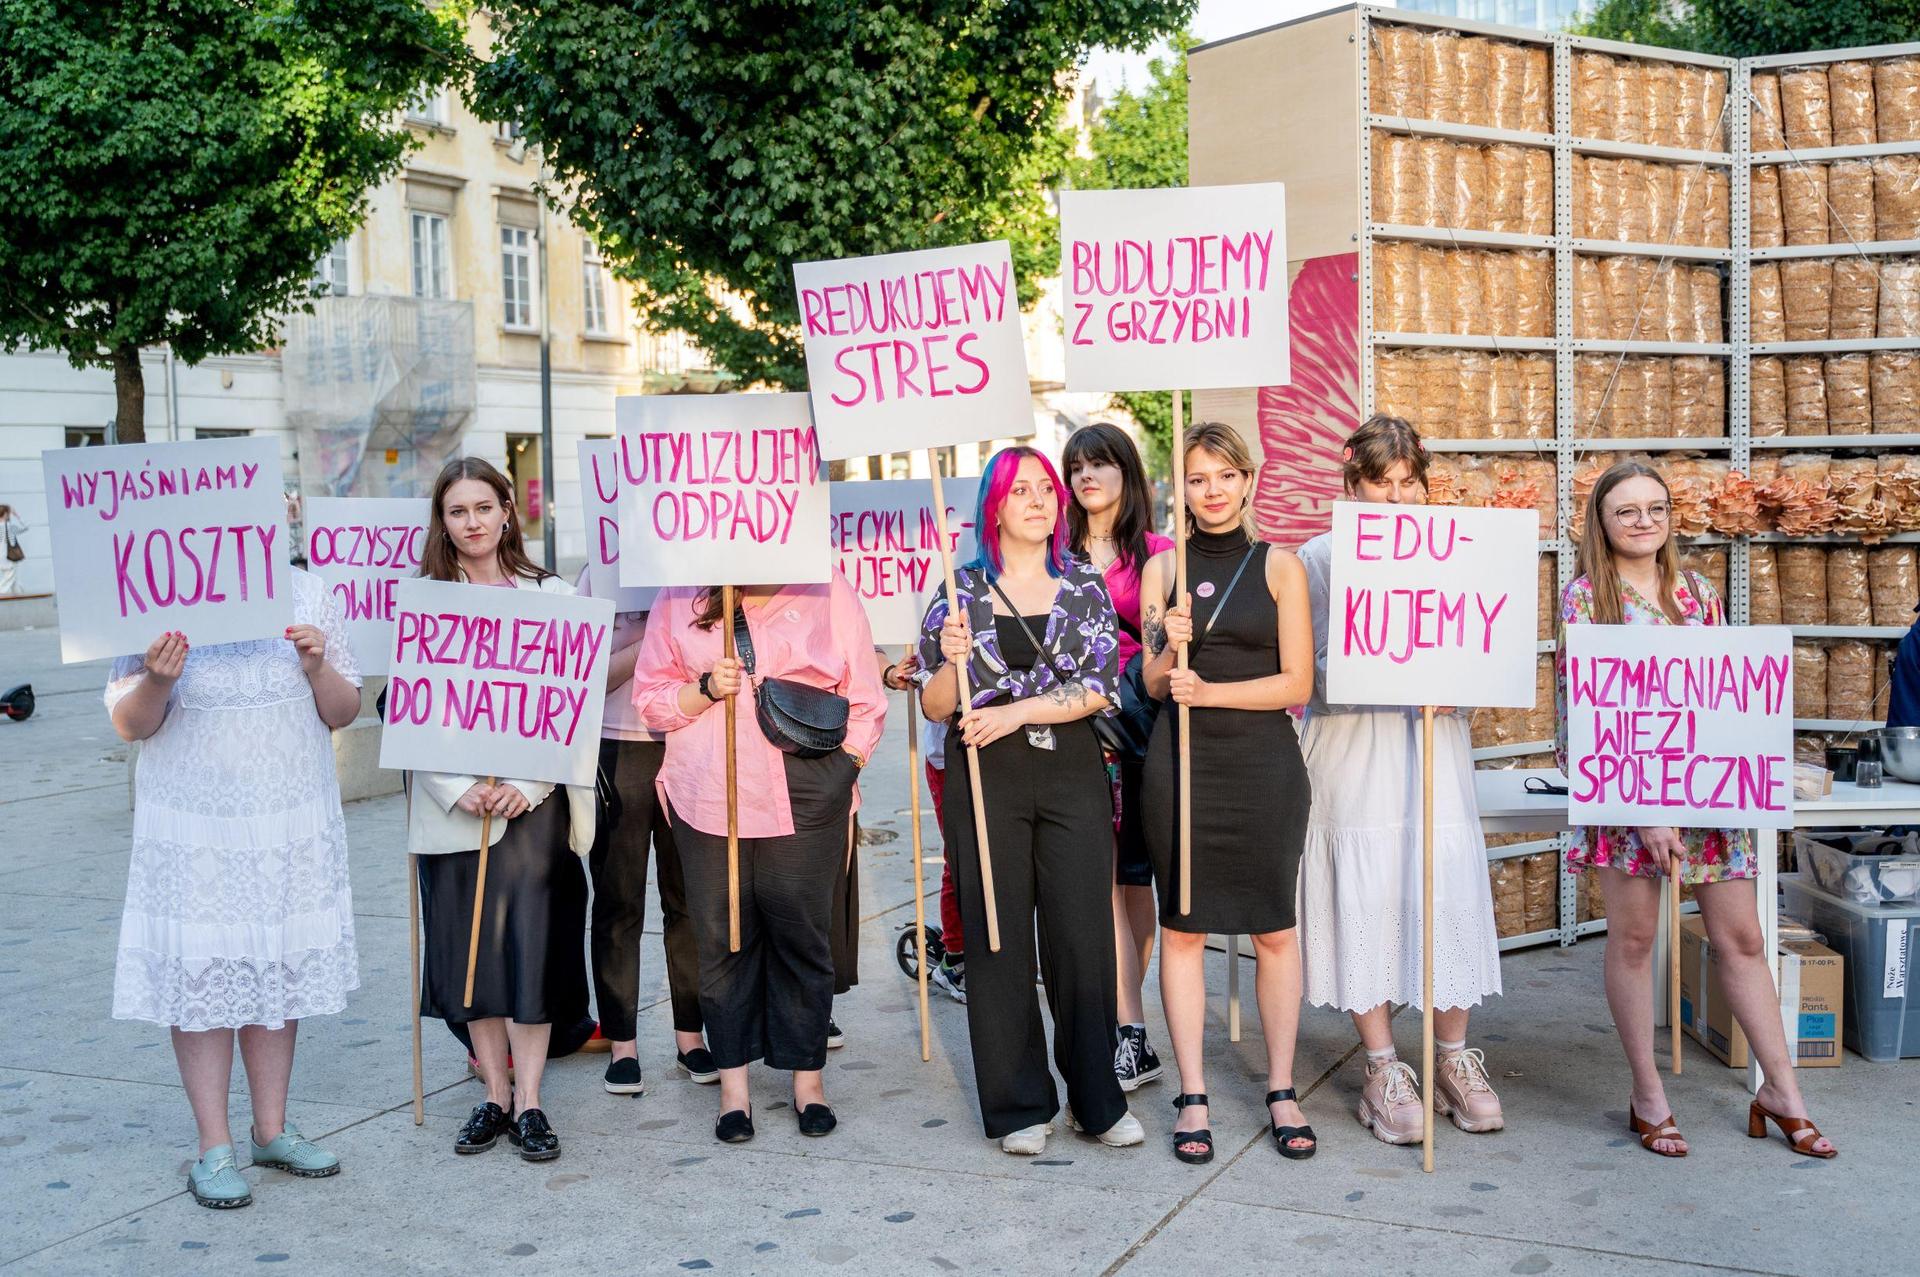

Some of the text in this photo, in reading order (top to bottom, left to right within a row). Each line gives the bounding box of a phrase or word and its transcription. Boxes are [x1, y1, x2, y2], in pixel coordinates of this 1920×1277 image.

[1072, 229, 1273, 298] BUDUJEMY
[801, 261, 1009, 337] REDUKUJEMY
[1072, 296, 1250, 345] Z GRZYBNI
[831, 332, 990, 407] STRES
[62, 459, 259, 521] WYJAŚNIAMY
[652, 488, 799, 544] ODPADY
[310, 525, 430, 568] OCZYSZC
[1356, 513, 1474, 561] EDU-
[113, 524, 276, 617] KOSZTY
[332, 578, 399, 621] OWIE
[1343, 586, 1508, 664] KUJEMY
[389, 676, 589, 746] DO NATURY
[1571, 654, 1789, 715] WZMACNIAMY
[1572, 753, 1786, 811] SPOŁECZNE
[1801, 1002, 1829, 1012] Pants
